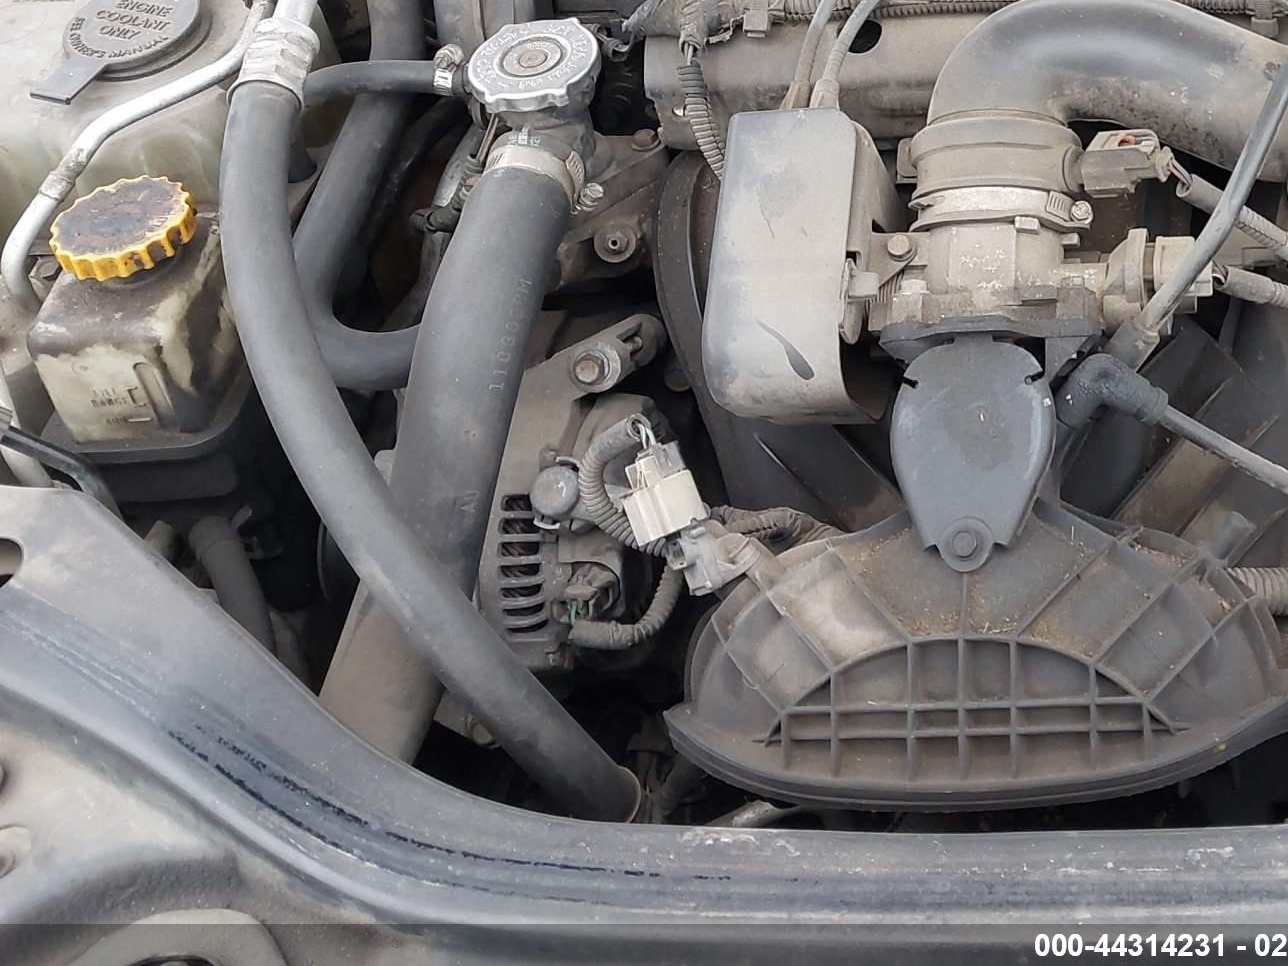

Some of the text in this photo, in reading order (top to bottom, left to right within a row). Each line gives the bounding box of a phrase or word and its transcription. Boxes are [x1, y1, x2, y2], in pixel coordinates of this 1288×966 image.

[96, 9, 171, 32] COOLANT
[69, 17, 86, 32] SEE
[107, 36, 169, 59] MANUAL
[99, 25, 142, 40] ONLY
